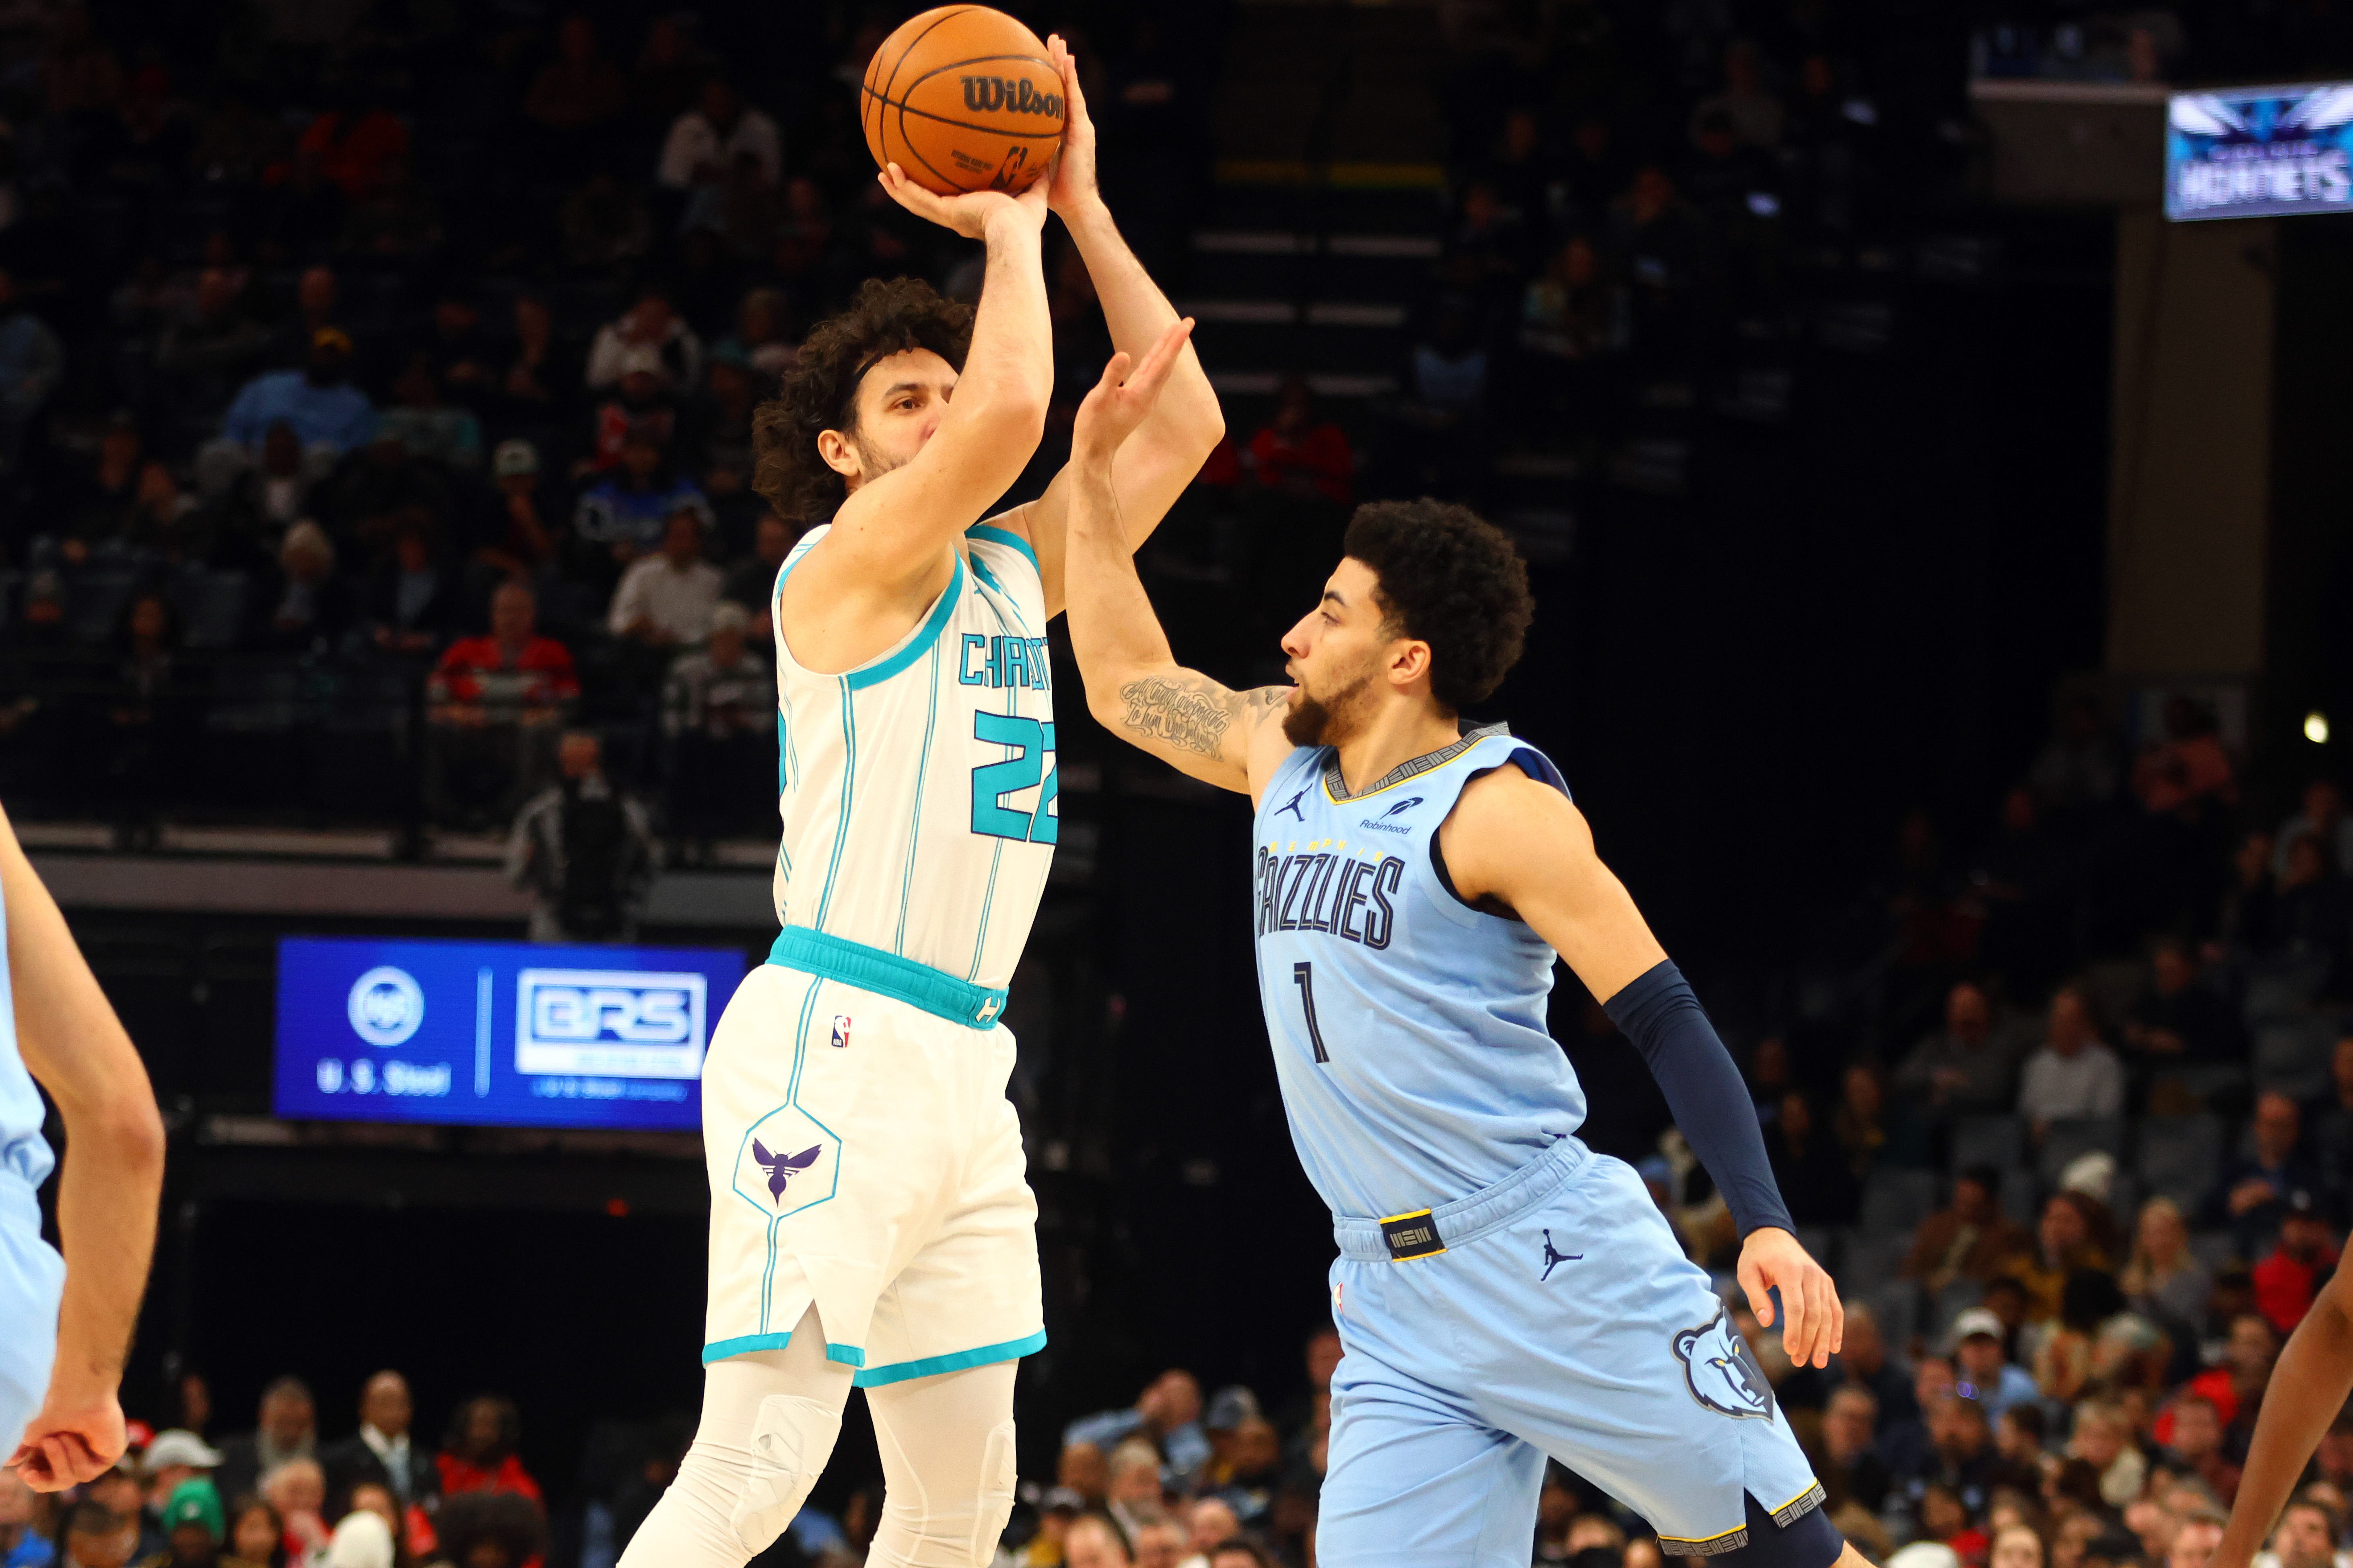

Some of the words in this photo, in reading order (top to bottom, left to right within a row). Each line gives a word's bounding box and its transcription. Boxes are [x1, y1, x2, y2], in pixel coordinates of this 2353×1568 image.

[960, 76, 1063, 121] Wilson
[1360, 819, 1412, 835] Robinhood
[1269, 838, 1384, 862] MEMPHIS
[1294, 962, 1330, 1064] 1
[833, 1038, 842, 1046] NBA
